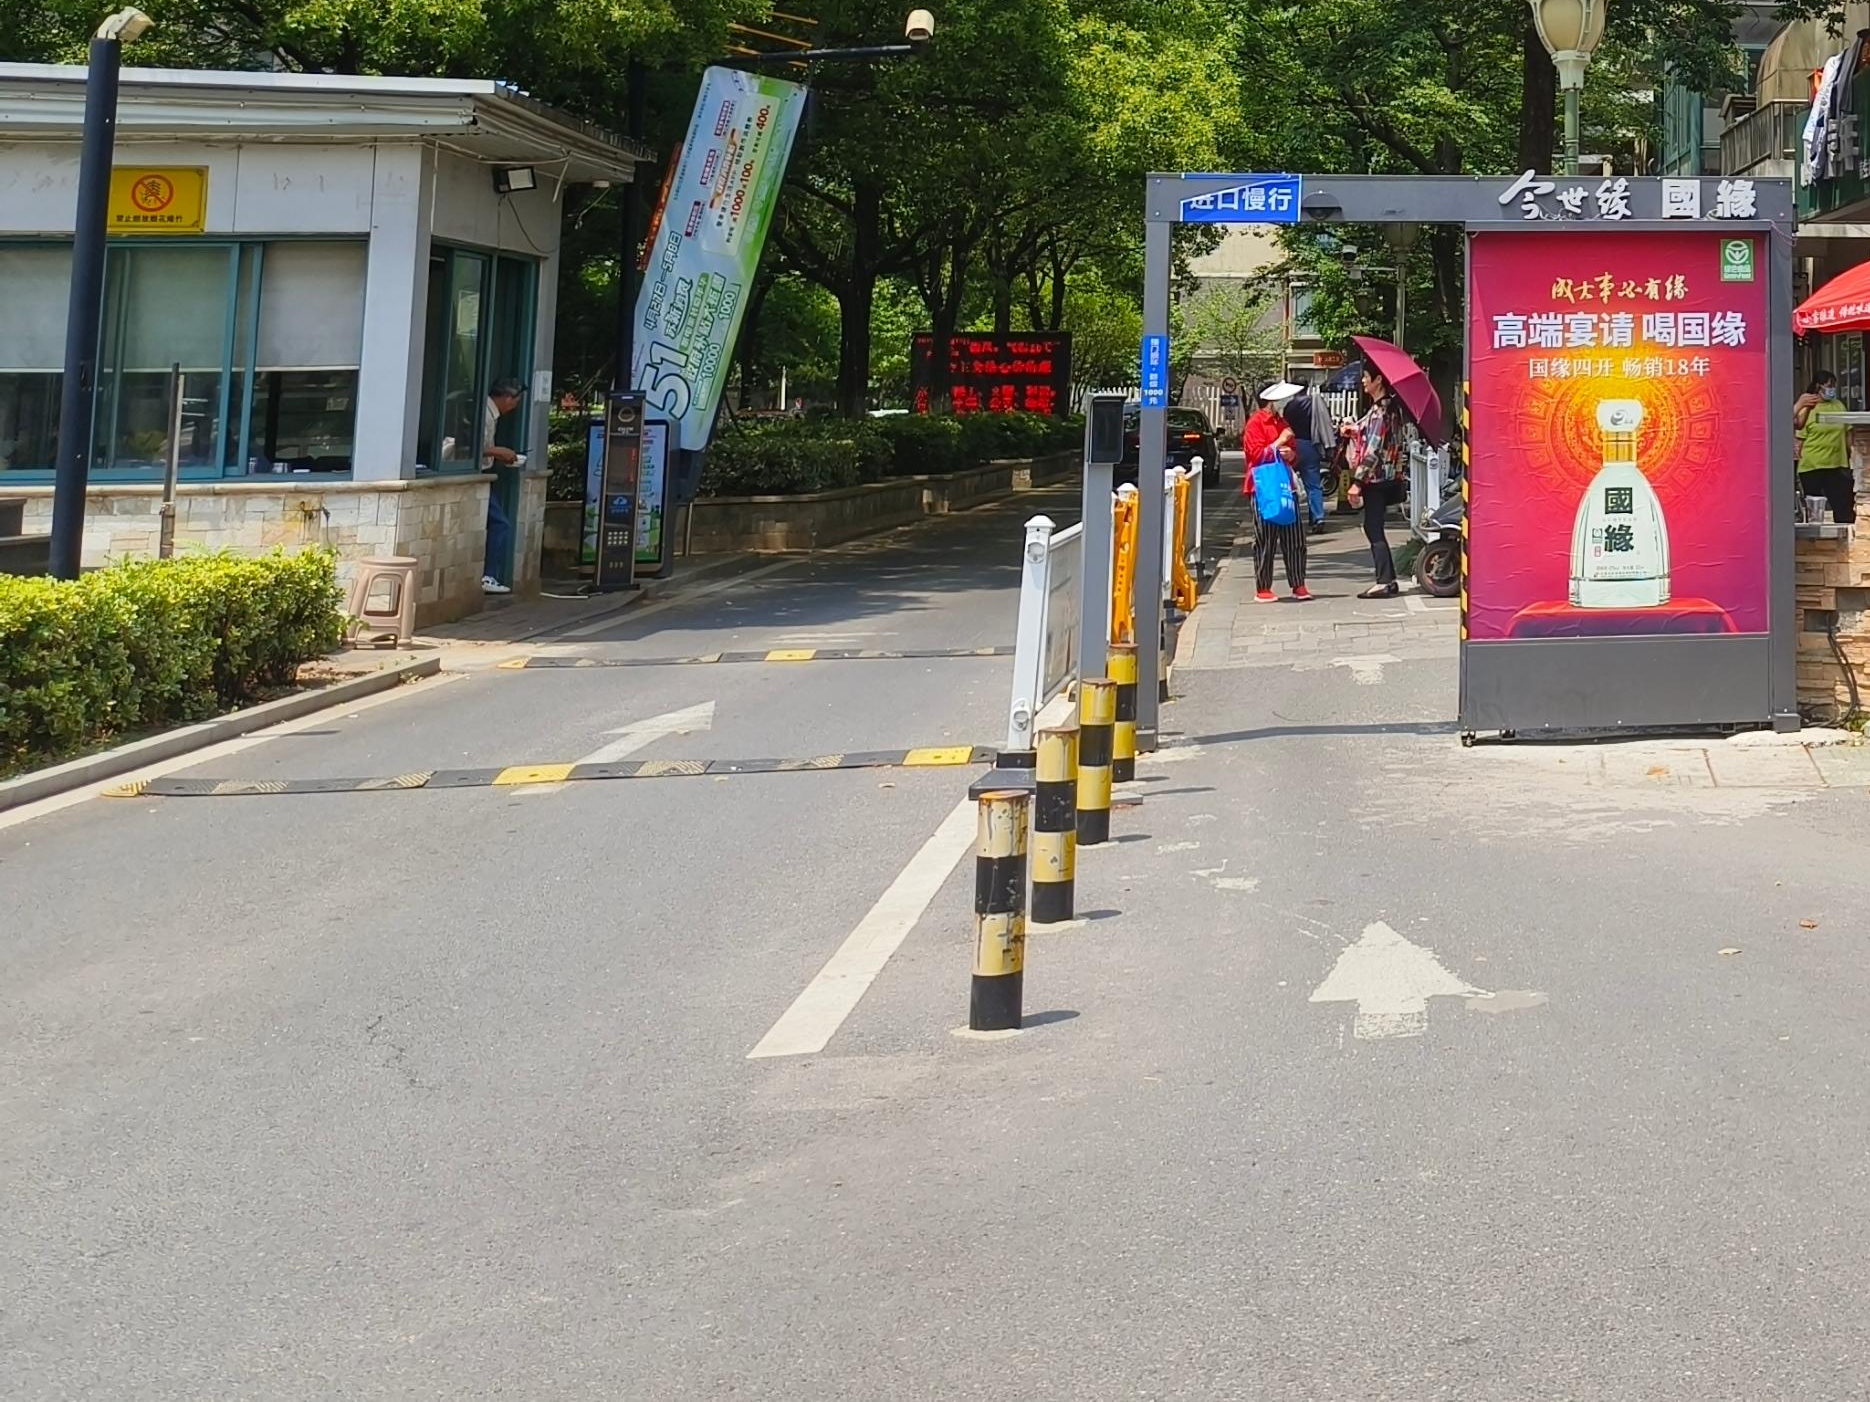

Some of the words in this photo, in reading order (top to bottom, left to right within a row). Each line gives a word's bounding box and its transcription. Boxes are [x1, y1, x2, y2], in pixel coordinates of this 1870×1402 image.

[1498, 169, 1632, 220] 今世缘
[1492, 311, 1635, 348] 高端宴请
[1642, 311, 1747, 347] 喝国缘
[638, 341, 691, 421] 51
[1529, 358, 1614, 378] 国缘四开
[1622, 355, 1711, 378] 畅销18年
